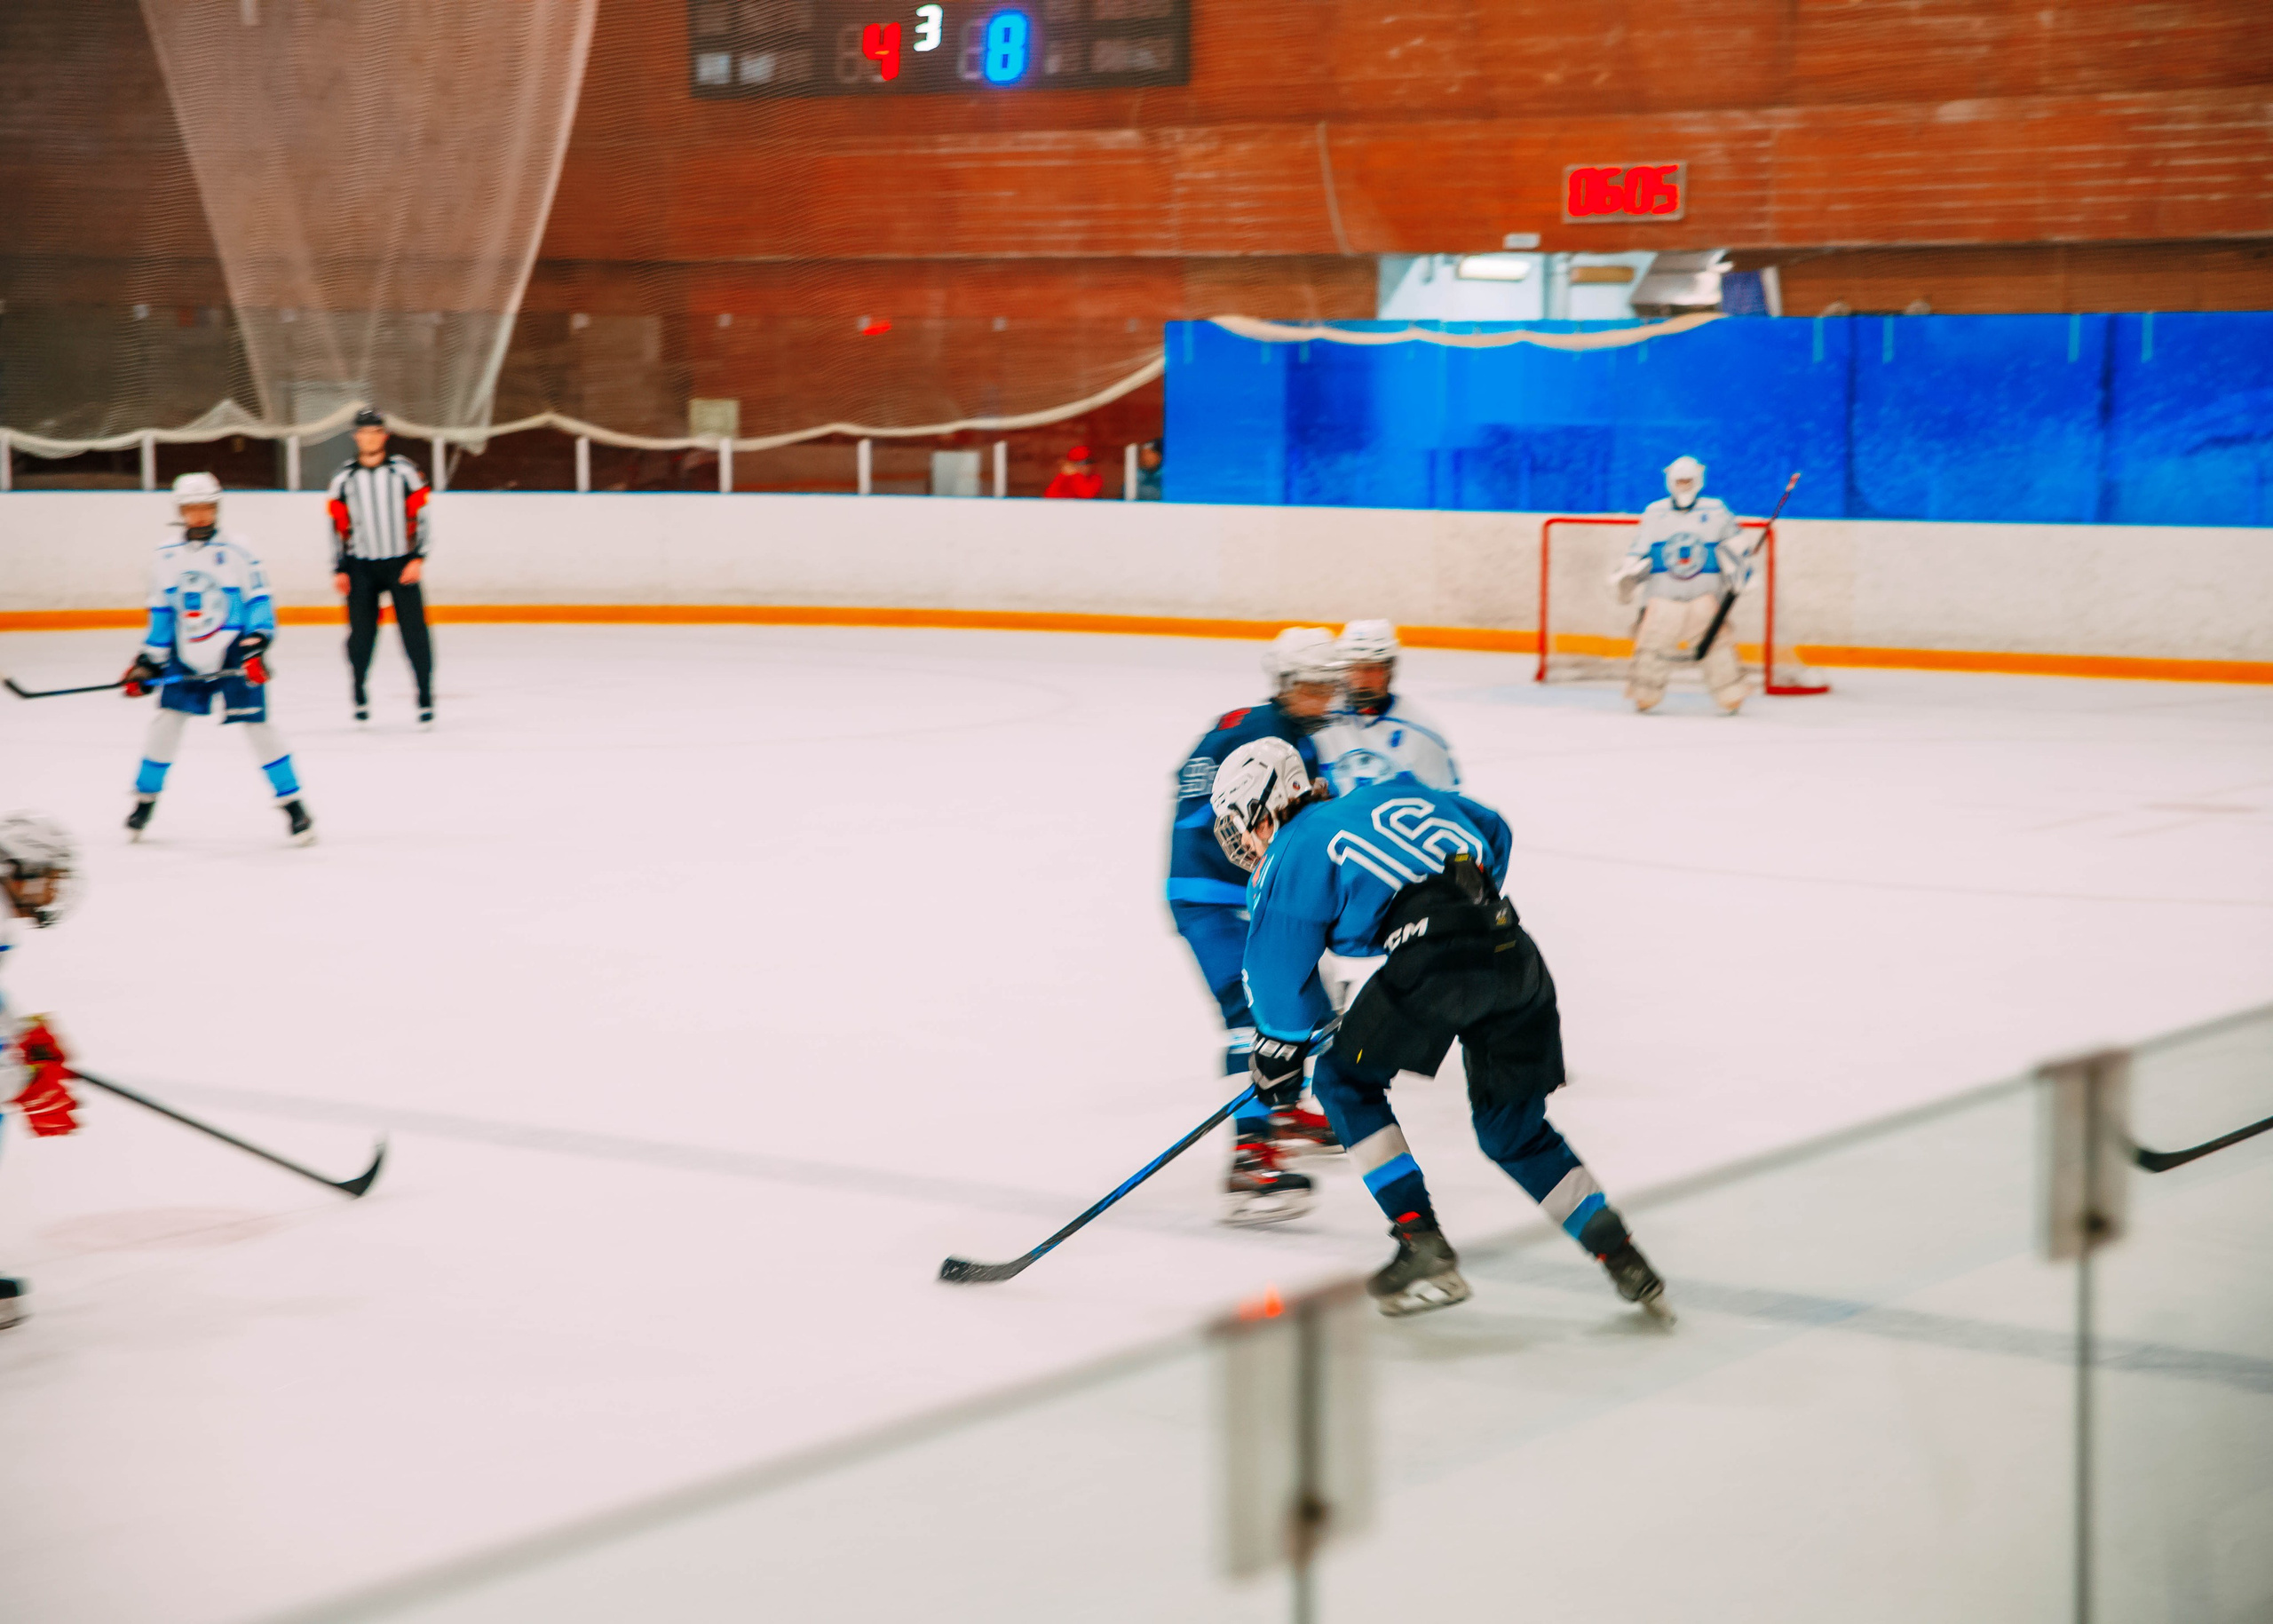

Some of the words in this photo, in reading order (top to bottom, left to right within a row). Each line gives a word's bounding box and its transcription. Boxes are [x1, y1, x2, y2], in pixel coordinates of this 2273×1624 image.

[862, 22, 901, 81] 4
[914, 4, 943, 51] 3
[985, 11, 1028, 84] 8
[1327, 797, 1483, 891] 16
